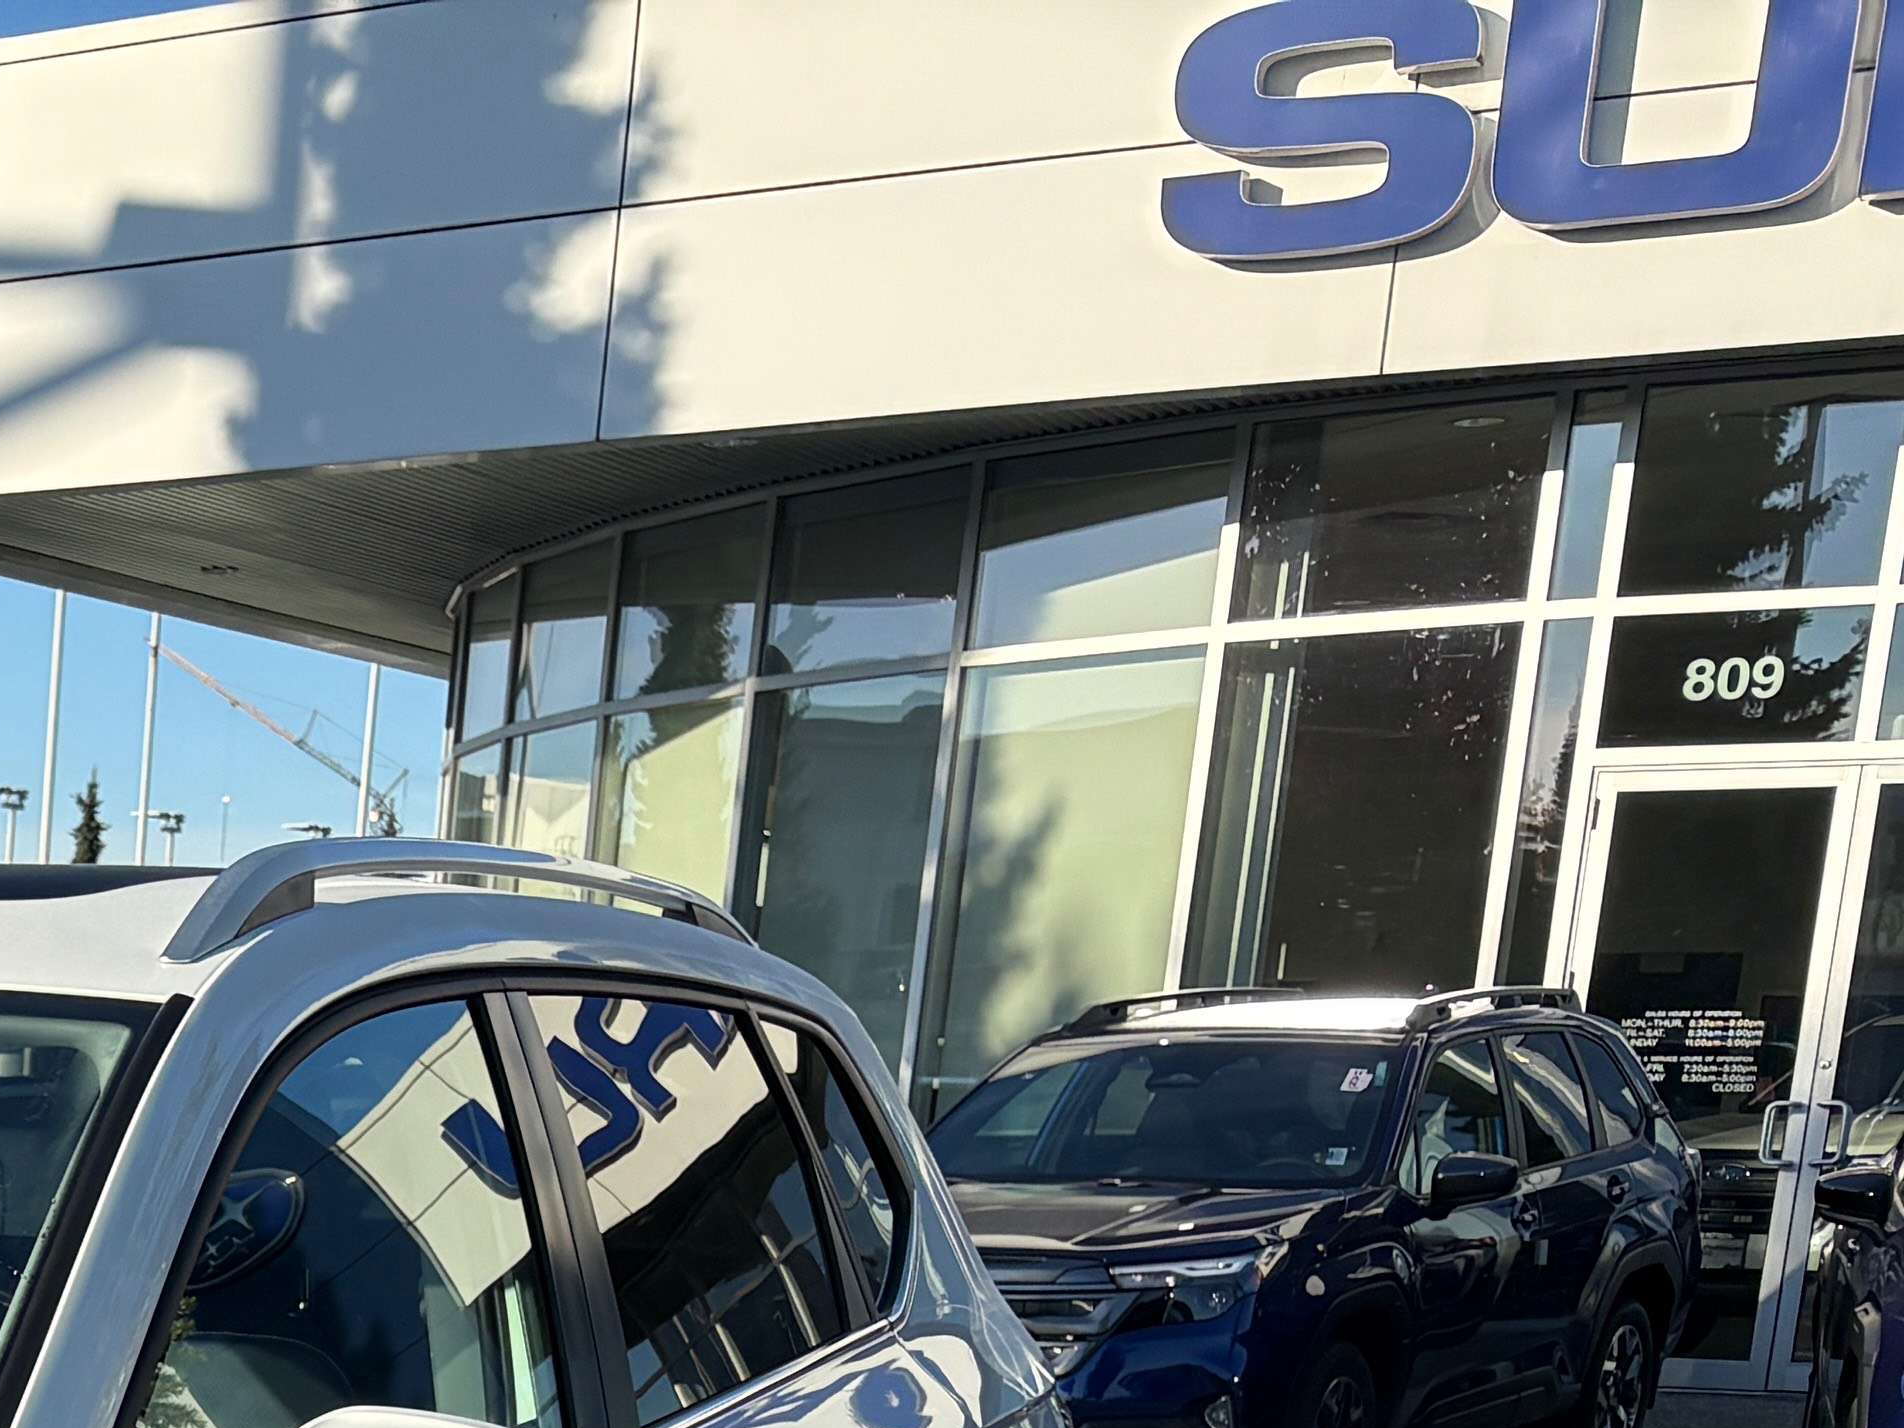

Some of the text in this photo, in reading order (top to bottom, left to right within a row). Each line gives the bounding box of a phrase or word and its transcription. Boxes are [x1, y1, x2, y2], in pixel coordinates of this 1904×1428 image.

[1161, 0, 1904, 260] SU
[1682, 655, 1785, 702] 809
[1712, 1083, 1754, 1093] CLOSED
